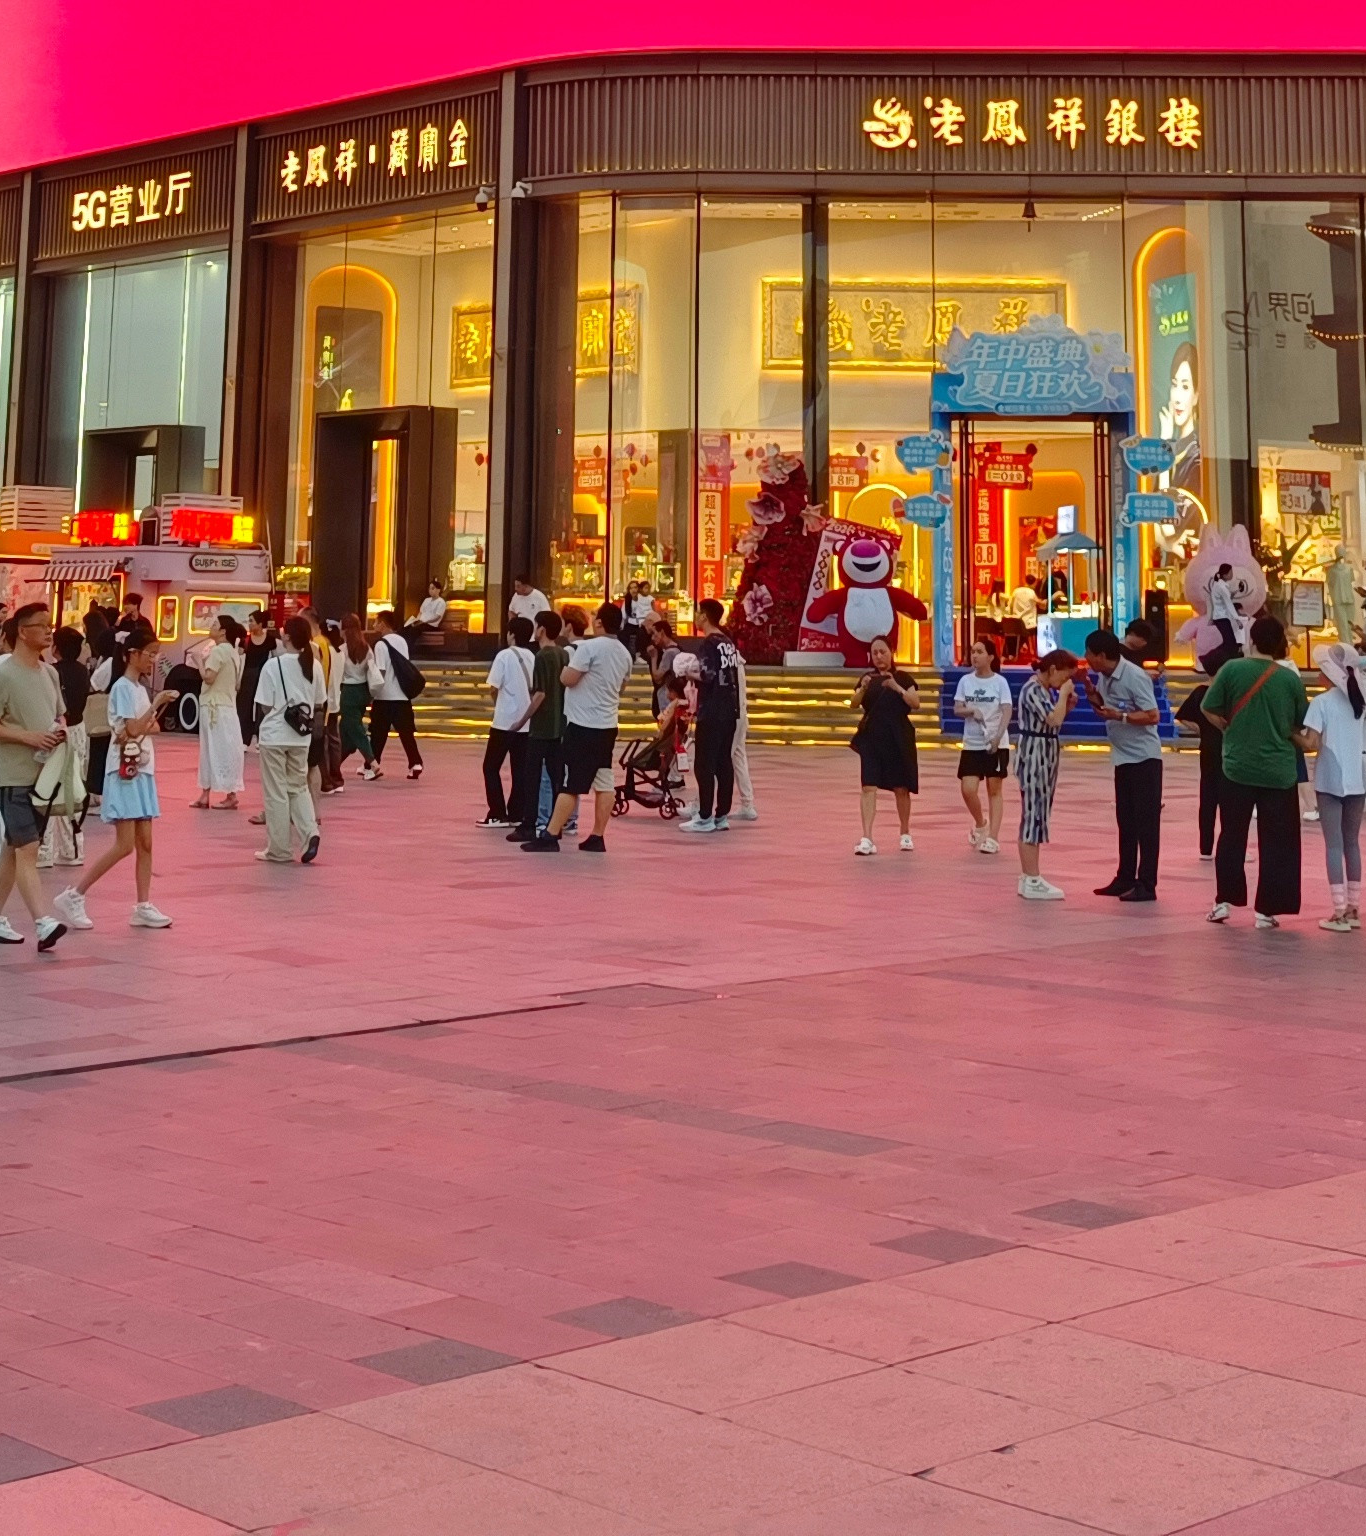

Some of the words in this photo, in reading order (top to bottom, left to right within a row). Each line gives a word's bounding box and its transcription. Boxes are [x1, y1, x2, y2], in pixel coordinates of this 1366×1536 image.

[72, 171, 192, 231] 5G营业厅
[968, 338, 1085, 369] 年中盛典
[971, 369, 1088, 400] 夏日狂欢
